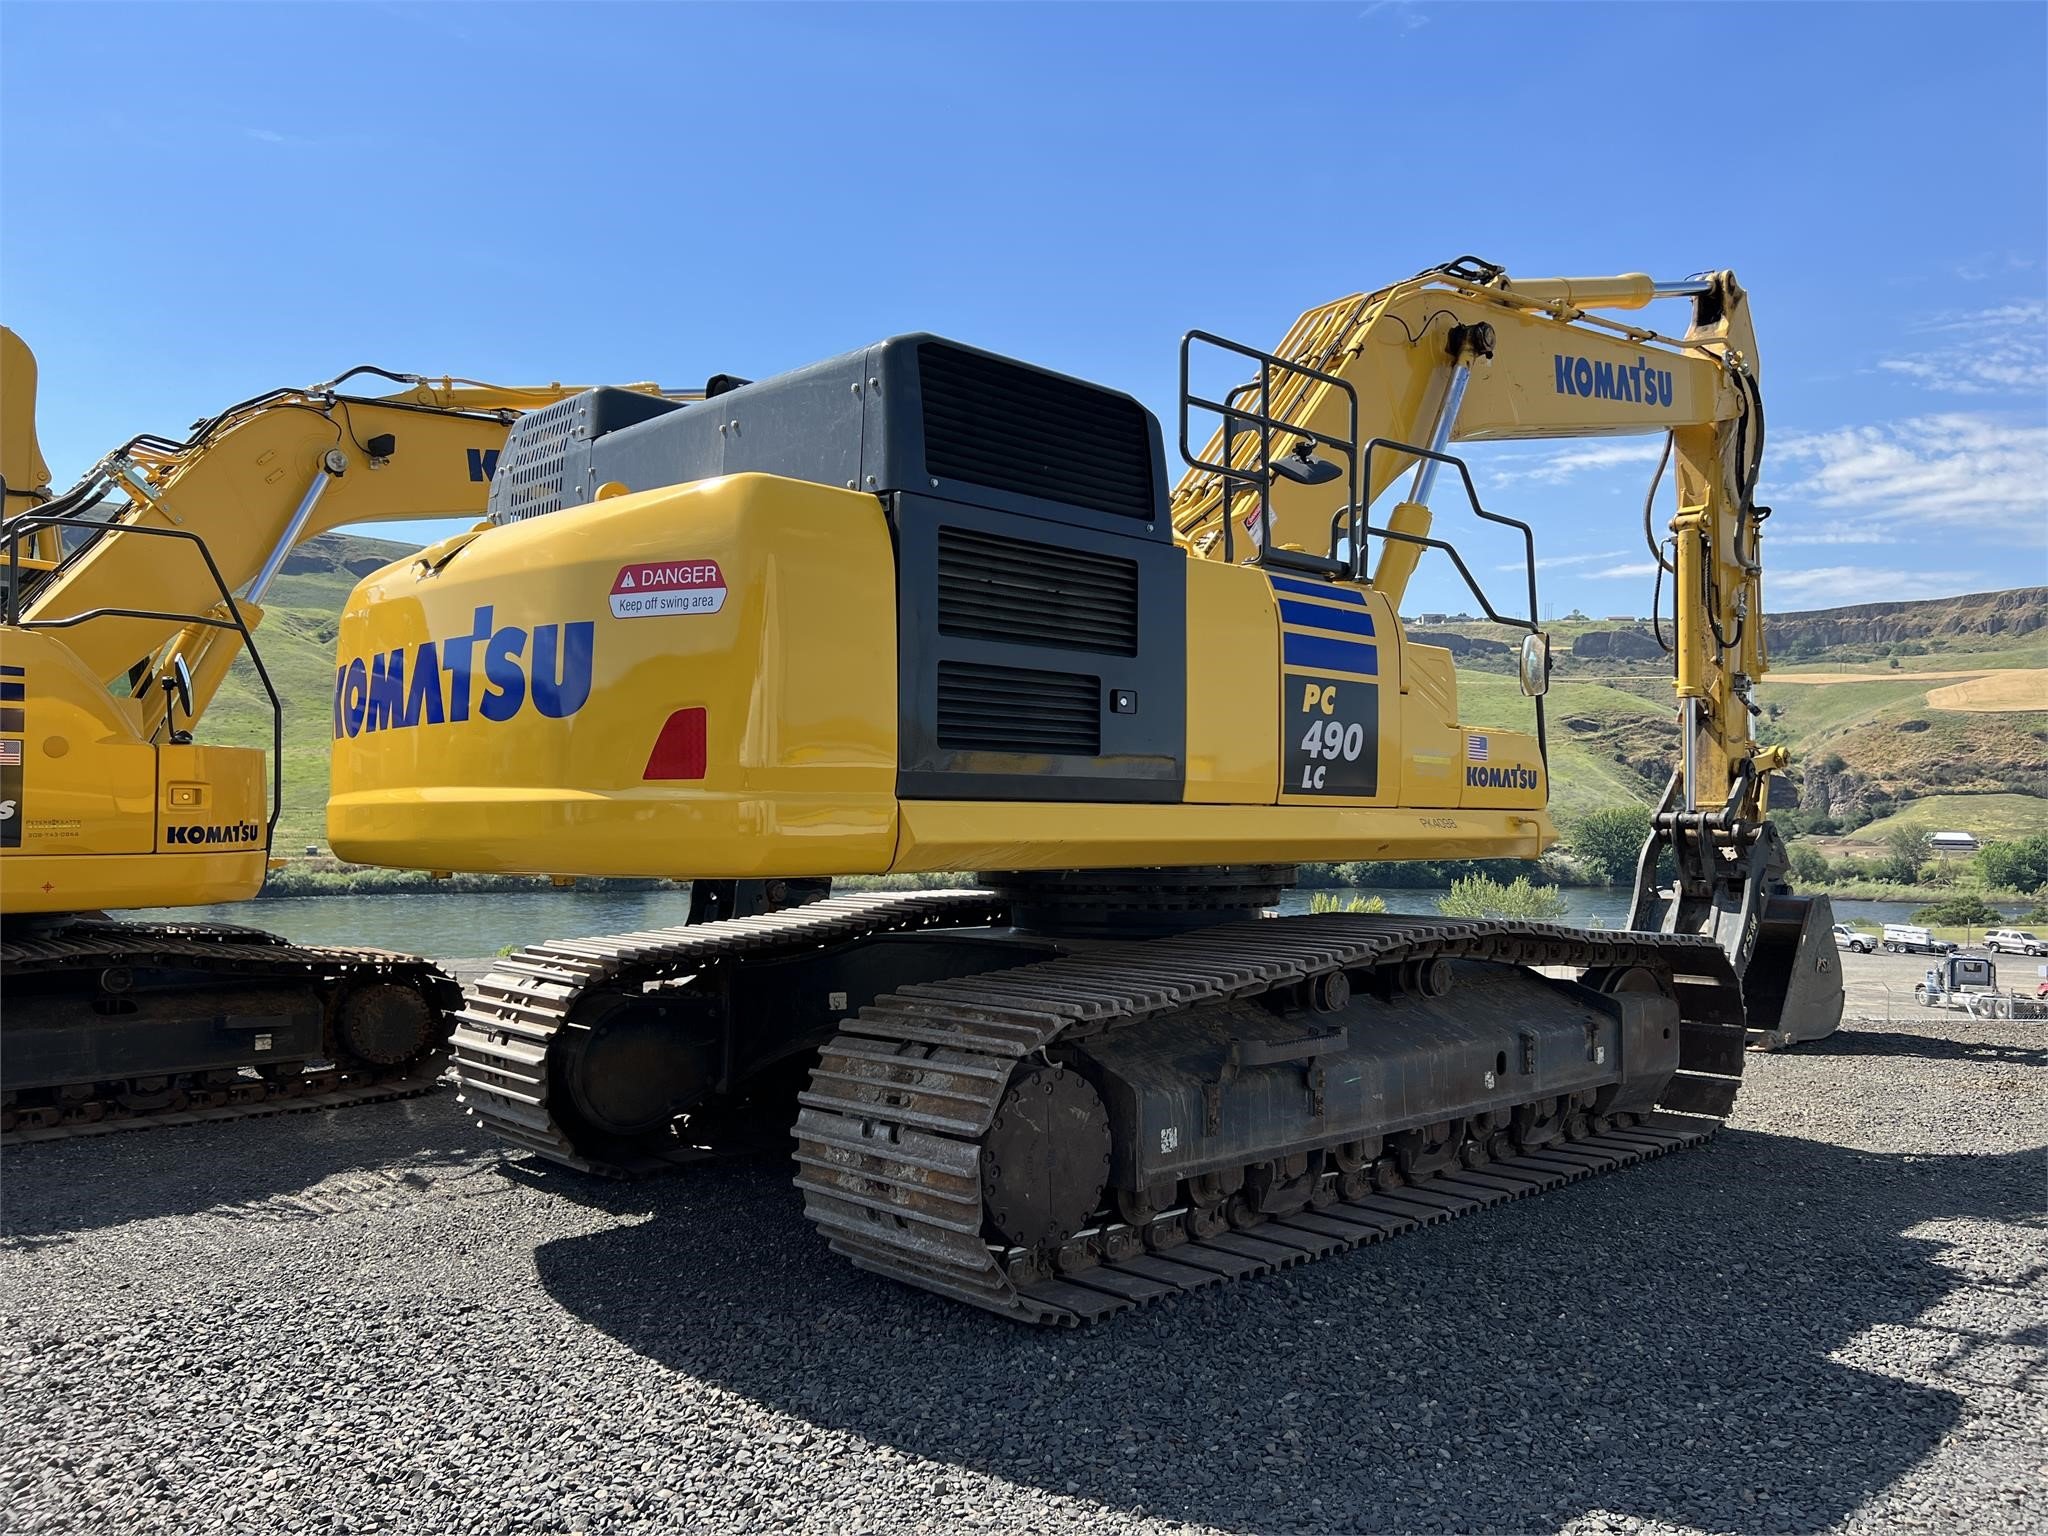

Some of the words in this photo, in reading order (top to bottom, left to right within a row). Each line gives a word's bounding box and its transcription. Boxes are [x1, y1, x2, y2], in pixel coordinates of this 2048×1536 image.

[1554, 354, 1673, 408] KOMATSU
[641, 566, 717, 586] DANGER
[619, 599, 643, 613] Keep
[645, 597, 658, 609] off
[660, 595, 689, 610] swing
[692, 596, 714, 607] area
[333, 605, 595, 739] KOMATSU
[1302, 683, 1338, 715] PC
[1301, 720, 1364, 762] 490
[1302, 765, 1327, 790] LC
[1466, 763, 1538, 790] KOMATSU
[167, 820, 259, 845] KOMATSU
